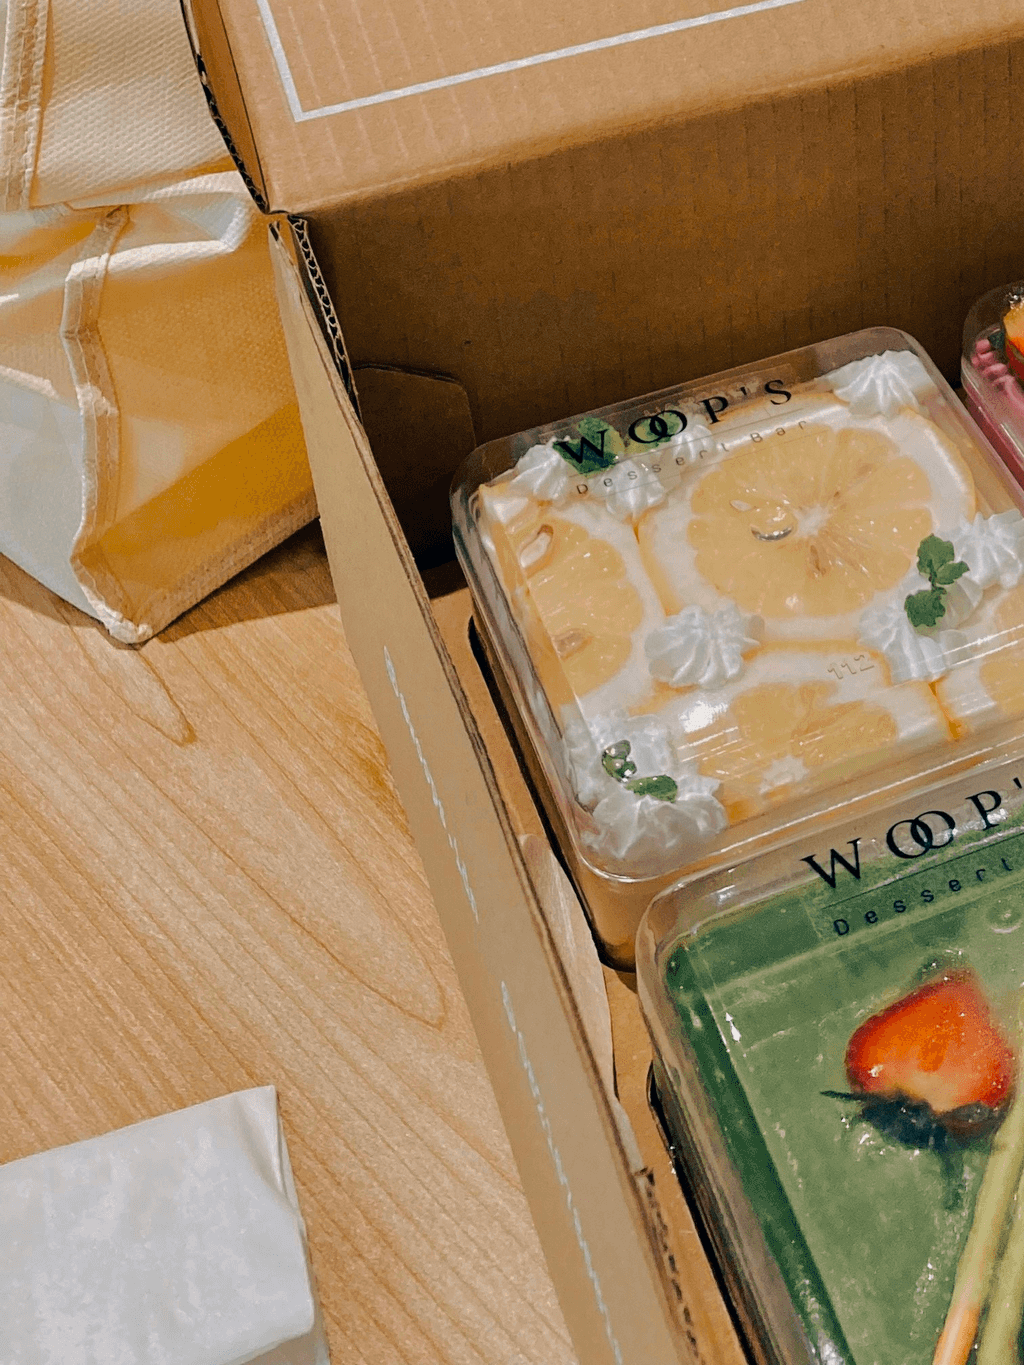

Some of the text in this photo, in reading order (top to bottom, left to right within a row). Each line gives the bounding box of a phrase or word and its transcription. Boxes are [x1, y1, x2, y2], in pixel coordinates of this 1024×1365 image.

[552, 379, 792, 465] WOOP'S
[576, 419, 807, 495] Dessert Bar
[833, 856, 1013, 936] Dessert
